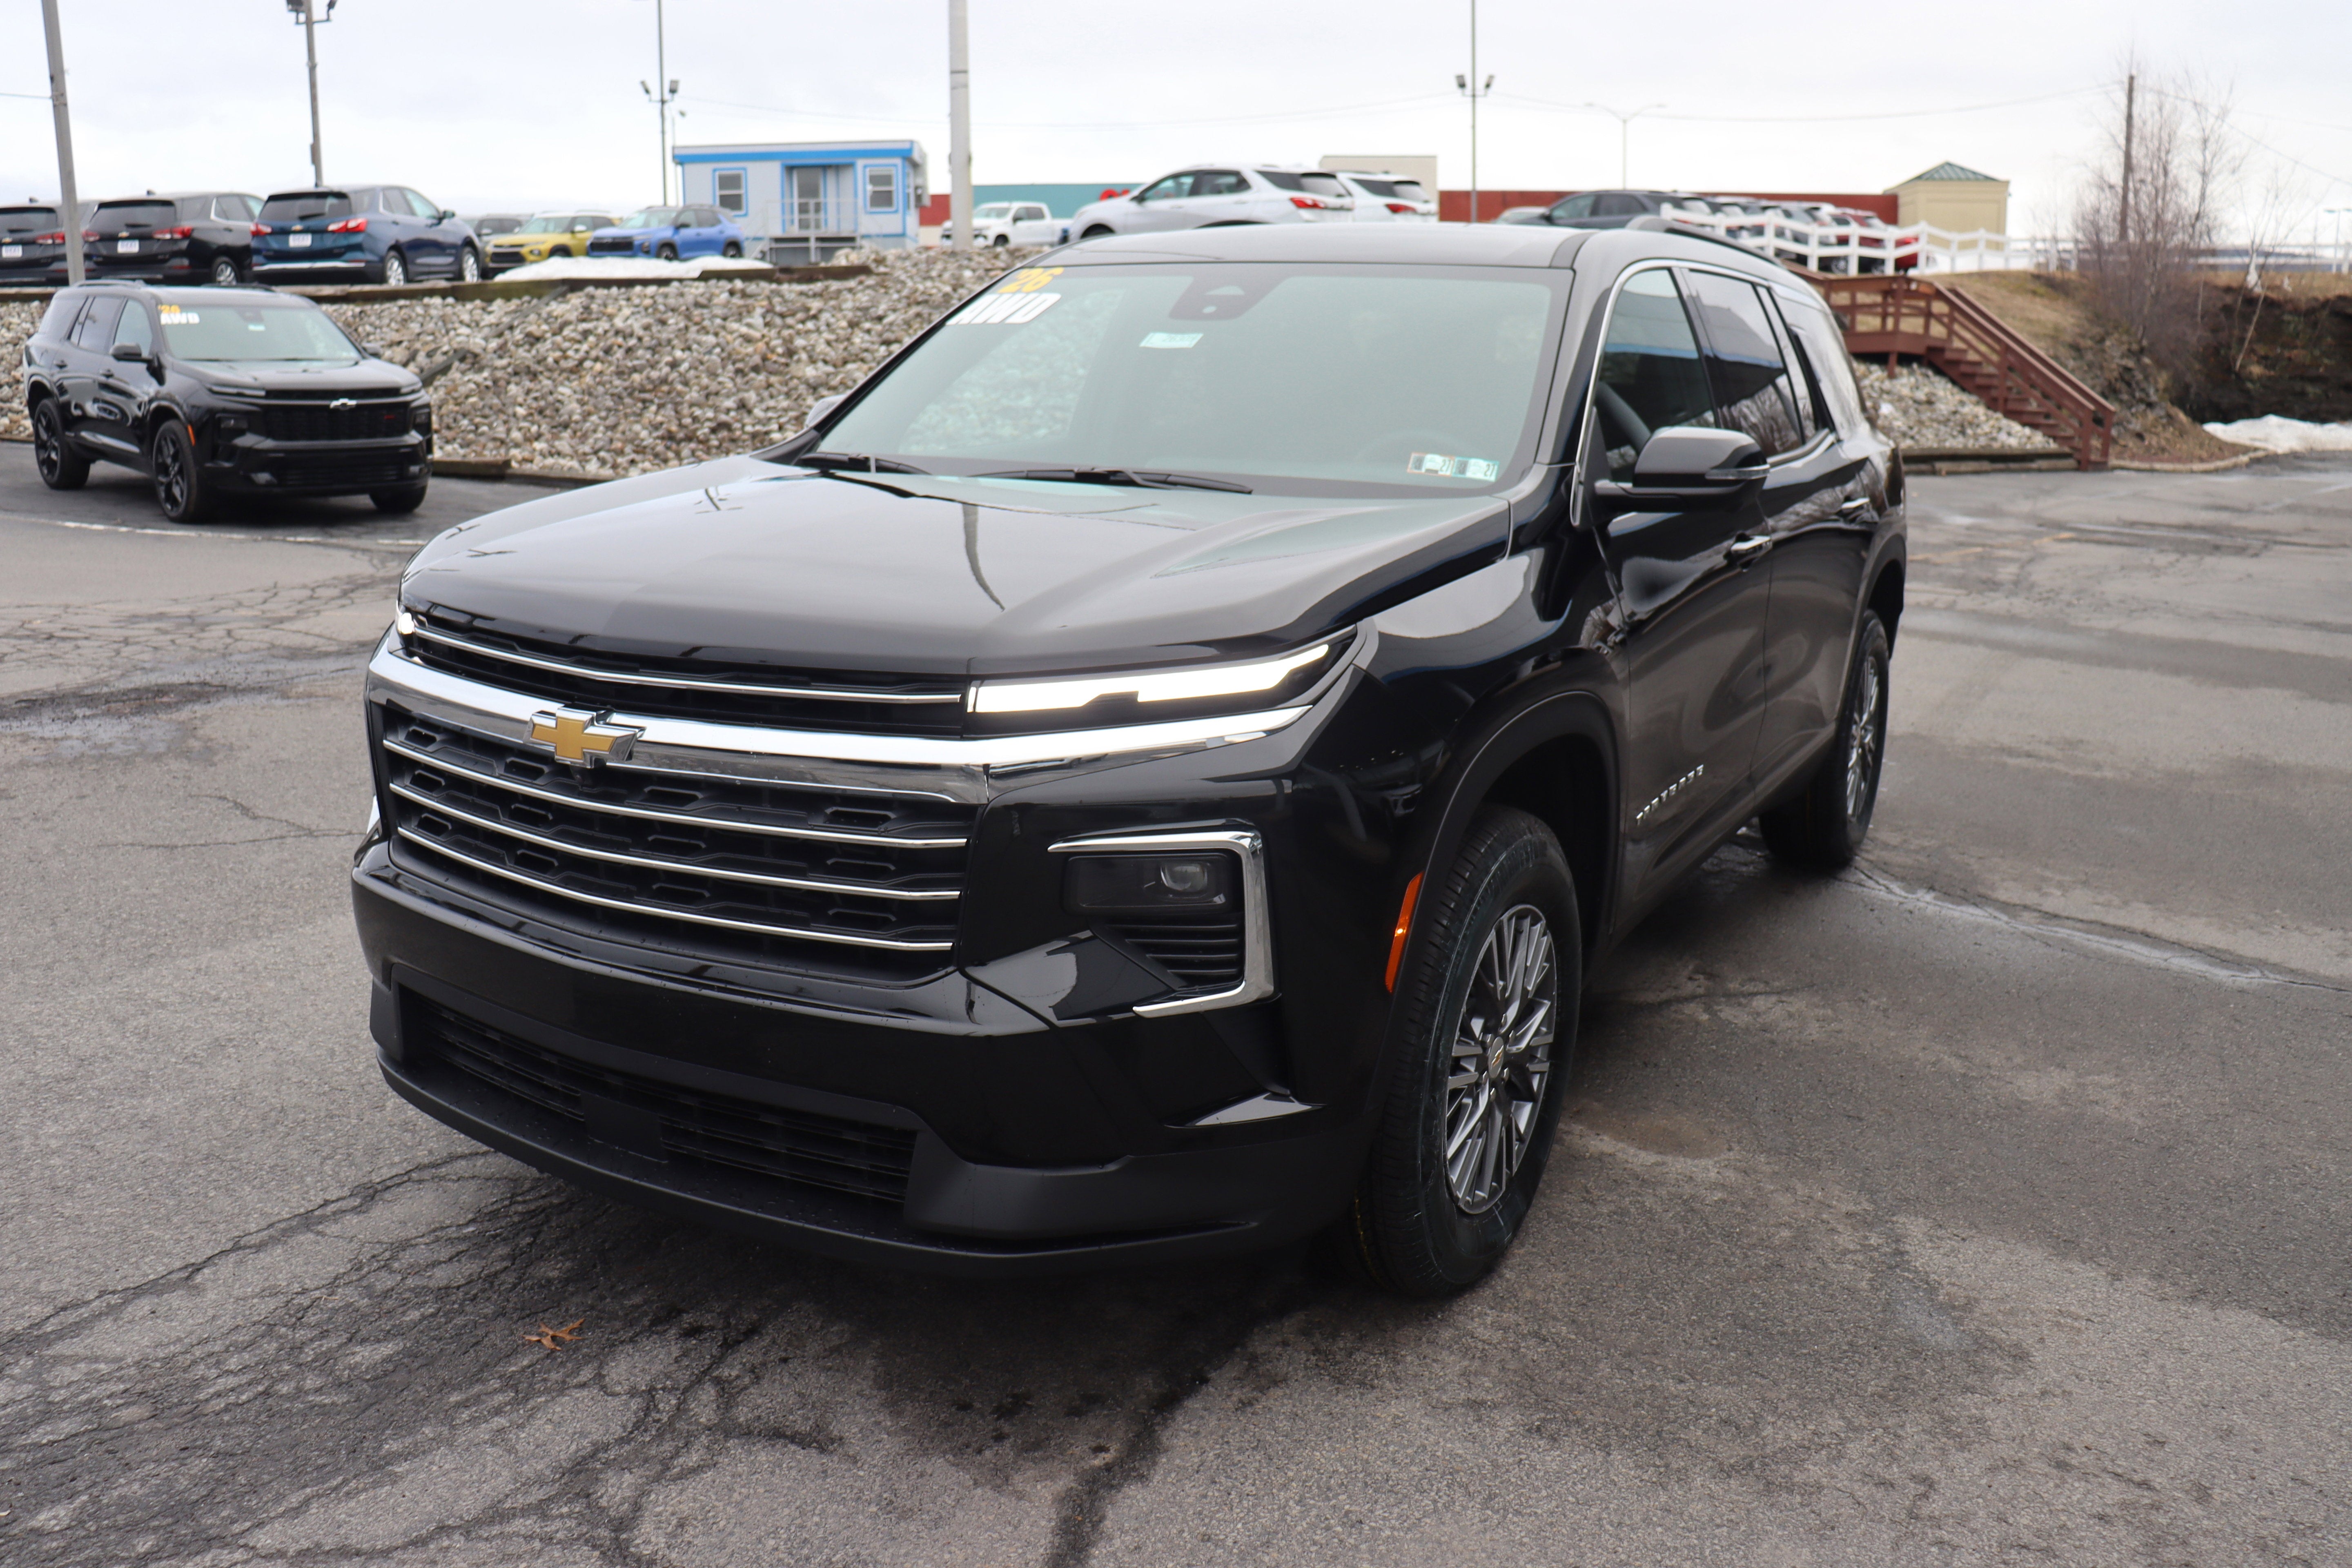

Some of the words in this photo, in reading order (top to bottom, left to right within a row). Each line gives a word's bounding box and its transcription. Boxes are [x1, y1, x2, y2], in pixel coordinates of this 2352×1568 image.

[945, 293, 1062, 324] AWD
[160, 313, 200, 325] AWD
[1440, 459, 1451, 472] 27
[1484, 463, 1495, 477] 27
